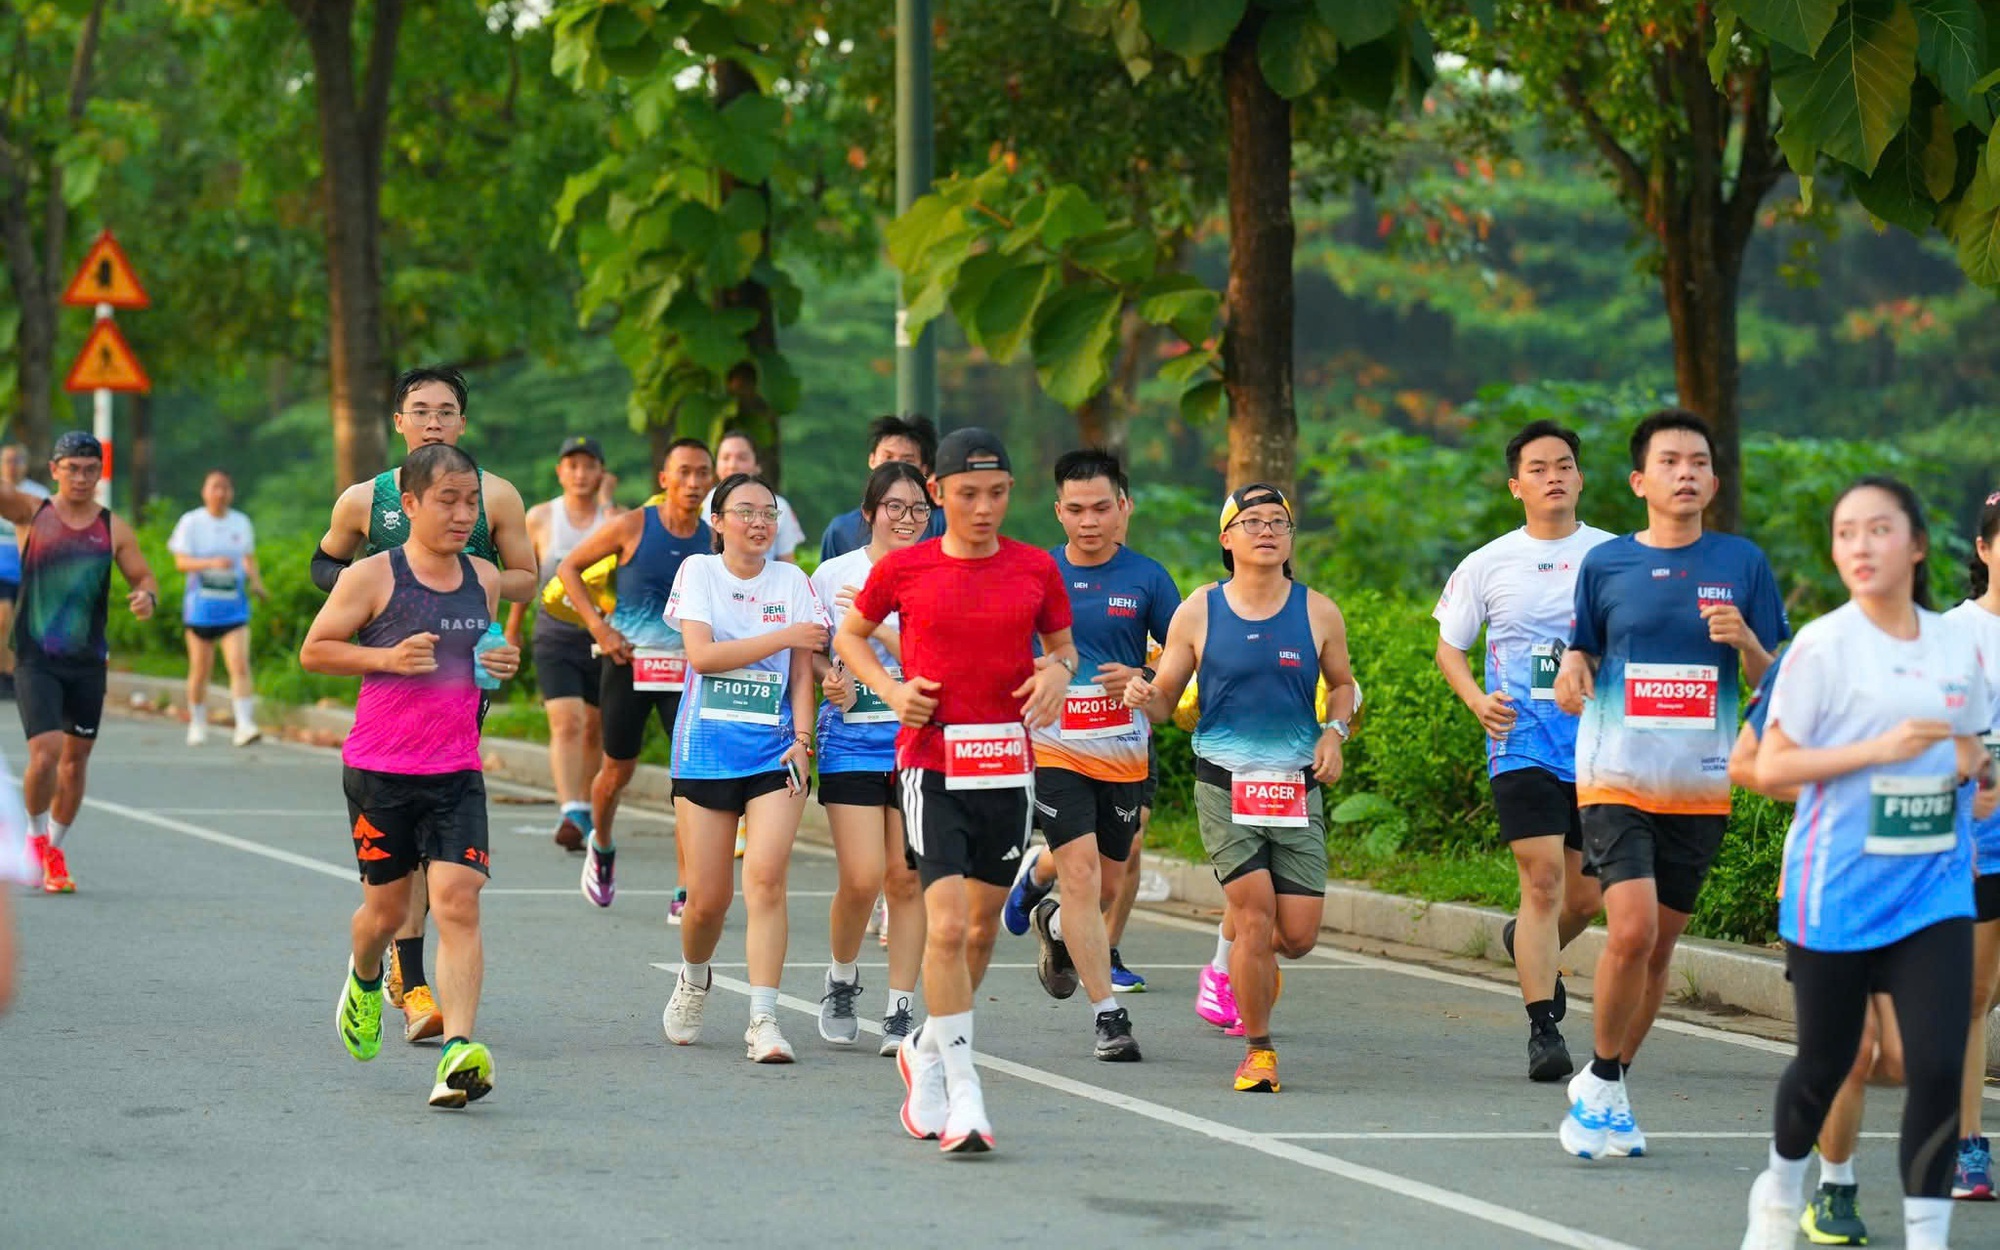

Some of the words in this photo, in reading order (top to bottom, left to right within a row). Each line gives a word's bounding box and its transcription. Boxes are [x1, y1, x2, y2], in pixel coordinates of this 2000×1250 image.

[1652, 568, 1670, 577] UEH
[1698, 587, 1725, 599] UEH
[1109, 597, 1131, 608] UEH
[763, 604, 781, 614] UEH
[763, 614, 782, 623] RUN
[1280, 651, 1296, 660] UEH
[713, 680, 770, 698] F10178
[1634, 682, 1707, 699] M20392
[1067, 699, 1124, 714] M20137
[955, 741, 1021, 758] M20540
[1245, 785, 1295, 800] PACER
